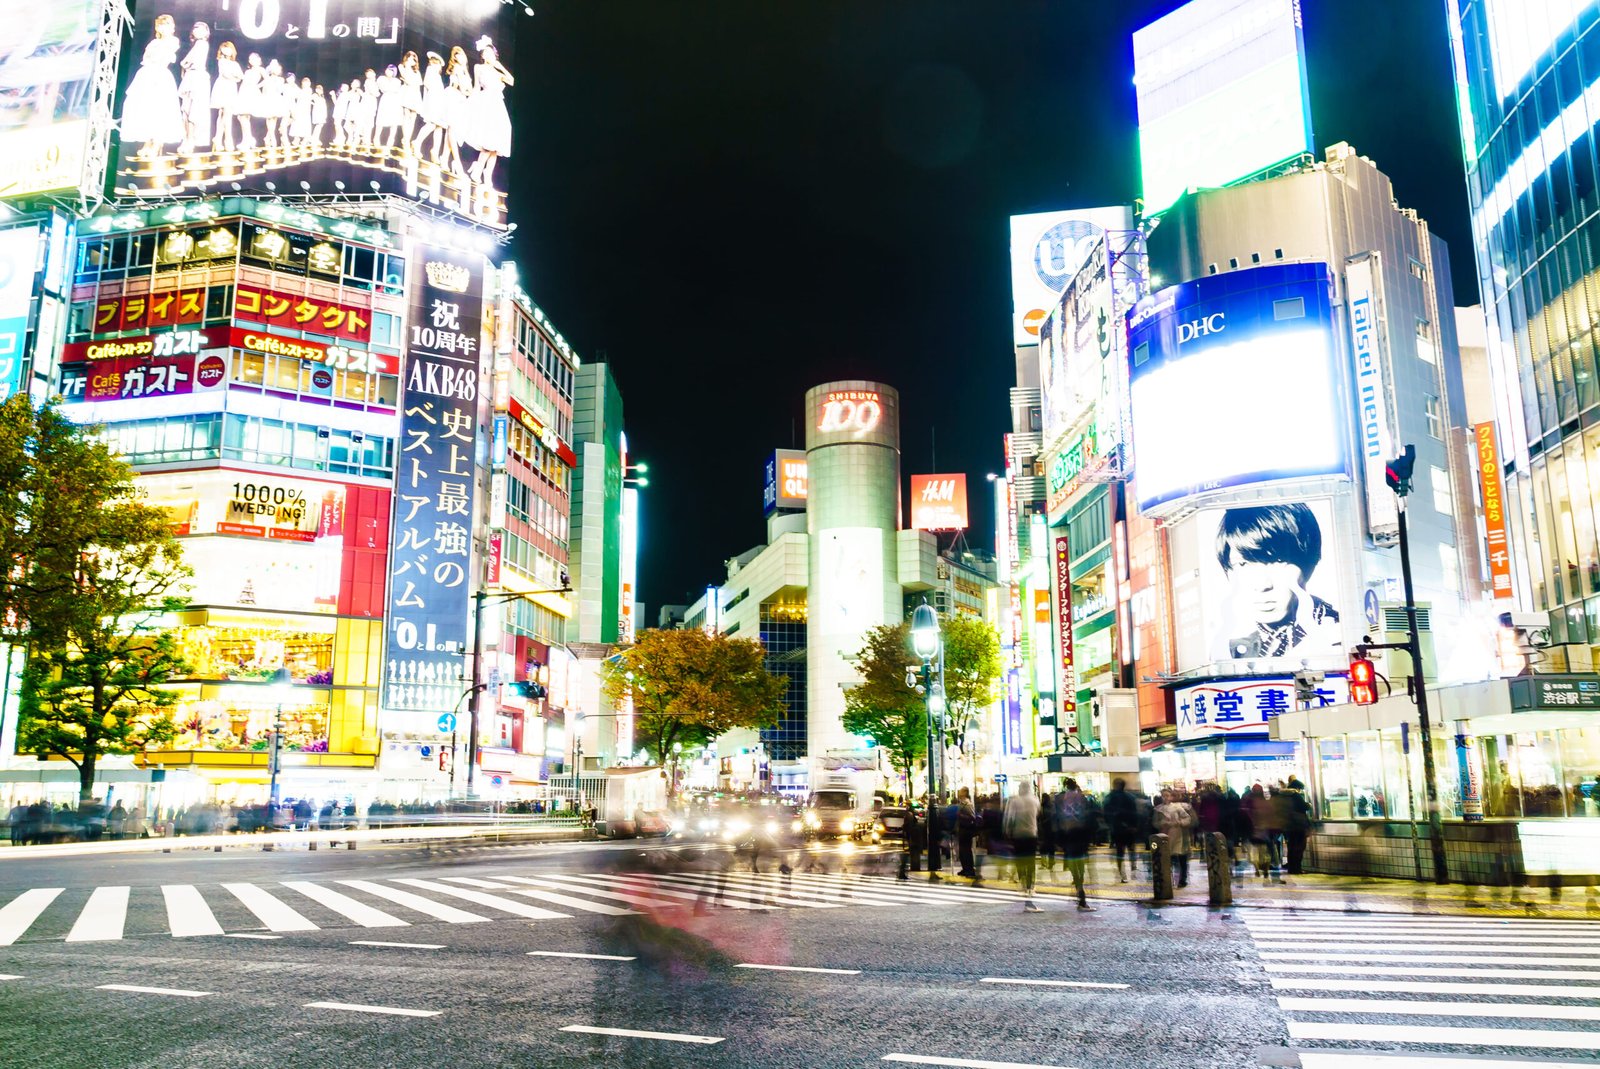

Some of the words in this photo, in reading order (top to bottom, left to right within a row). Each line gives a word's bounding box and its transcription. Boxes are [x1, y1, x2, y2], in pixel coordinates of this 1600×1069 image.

[98, 292, 202, 326] プライス
[235, 289, 367, 334] コンタクト
[430, 299, 460, 331] 祝
[153, 330, 209, 357] ガスト
[411, 325, 477, 356] 10周年
[1178, 312, 1226, 344] DHC
[200, 369, 223, 379] ガスト
[324, 345, 387, 374] ガスト
[63, 377, 87, 396] 7F
[121, 365, 188, 397] ガスト
[407, 358, 476, 401] AKB48
[829, 392, 879, 402] SHIBUYA
[817, 400, 881, 438] 109
[1363, 386, 1381, 458] neon
[785, 463, 807, 478] UN
[1478, 426, 1501, 522] クスリのことなら
[233, 482, 307, 508] 1000%
[433, 408, 474, 588] 史上最強の
[785, 479, 807, 496] QL
[393, 402, 437, 609] ベストアルバム
[1488, 529, 1512, 590] 三千里
